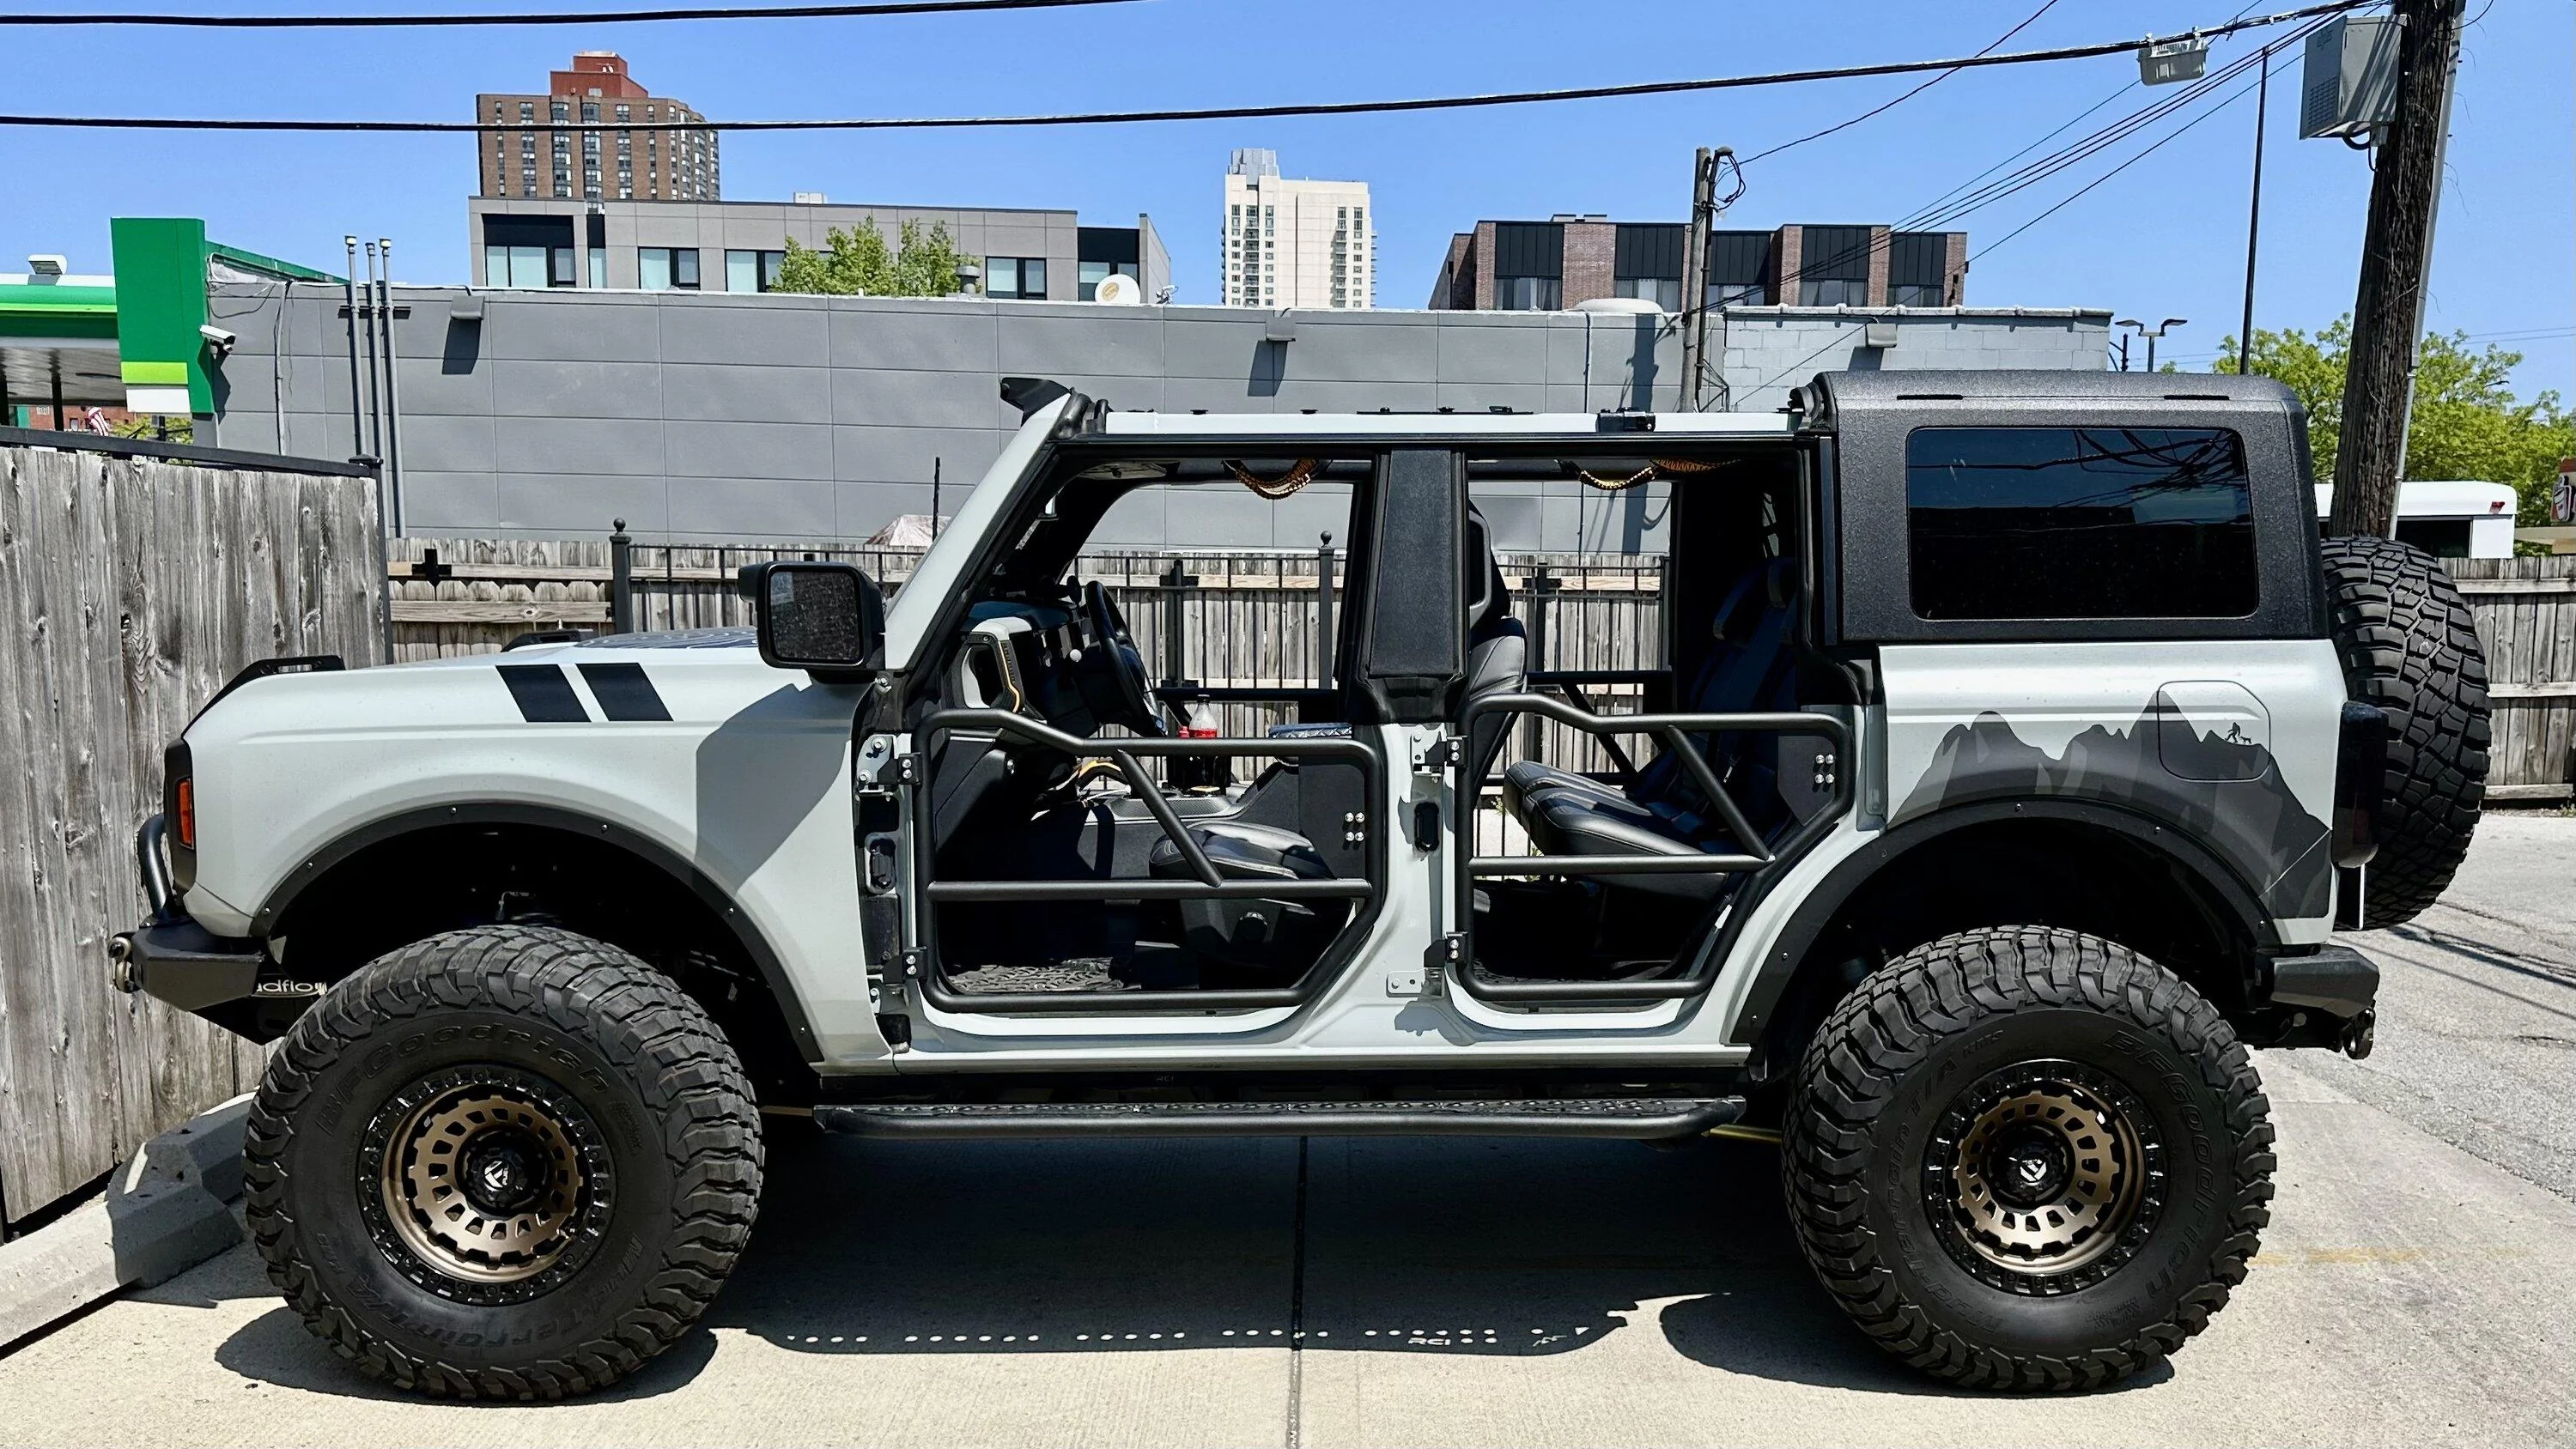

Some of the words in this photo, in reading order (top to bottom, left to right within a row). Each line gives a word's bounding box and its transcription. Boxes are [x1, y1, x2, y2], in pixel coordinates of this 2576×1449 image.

[314, 1022, 610, 1136] BFGoodrich
[1888, 1122, 2004, 1332] Mud-Terrain
[2104, 1030, 2217, 1298] BFGoodrich
[1408, 1337, 1451, 1346] RCI
